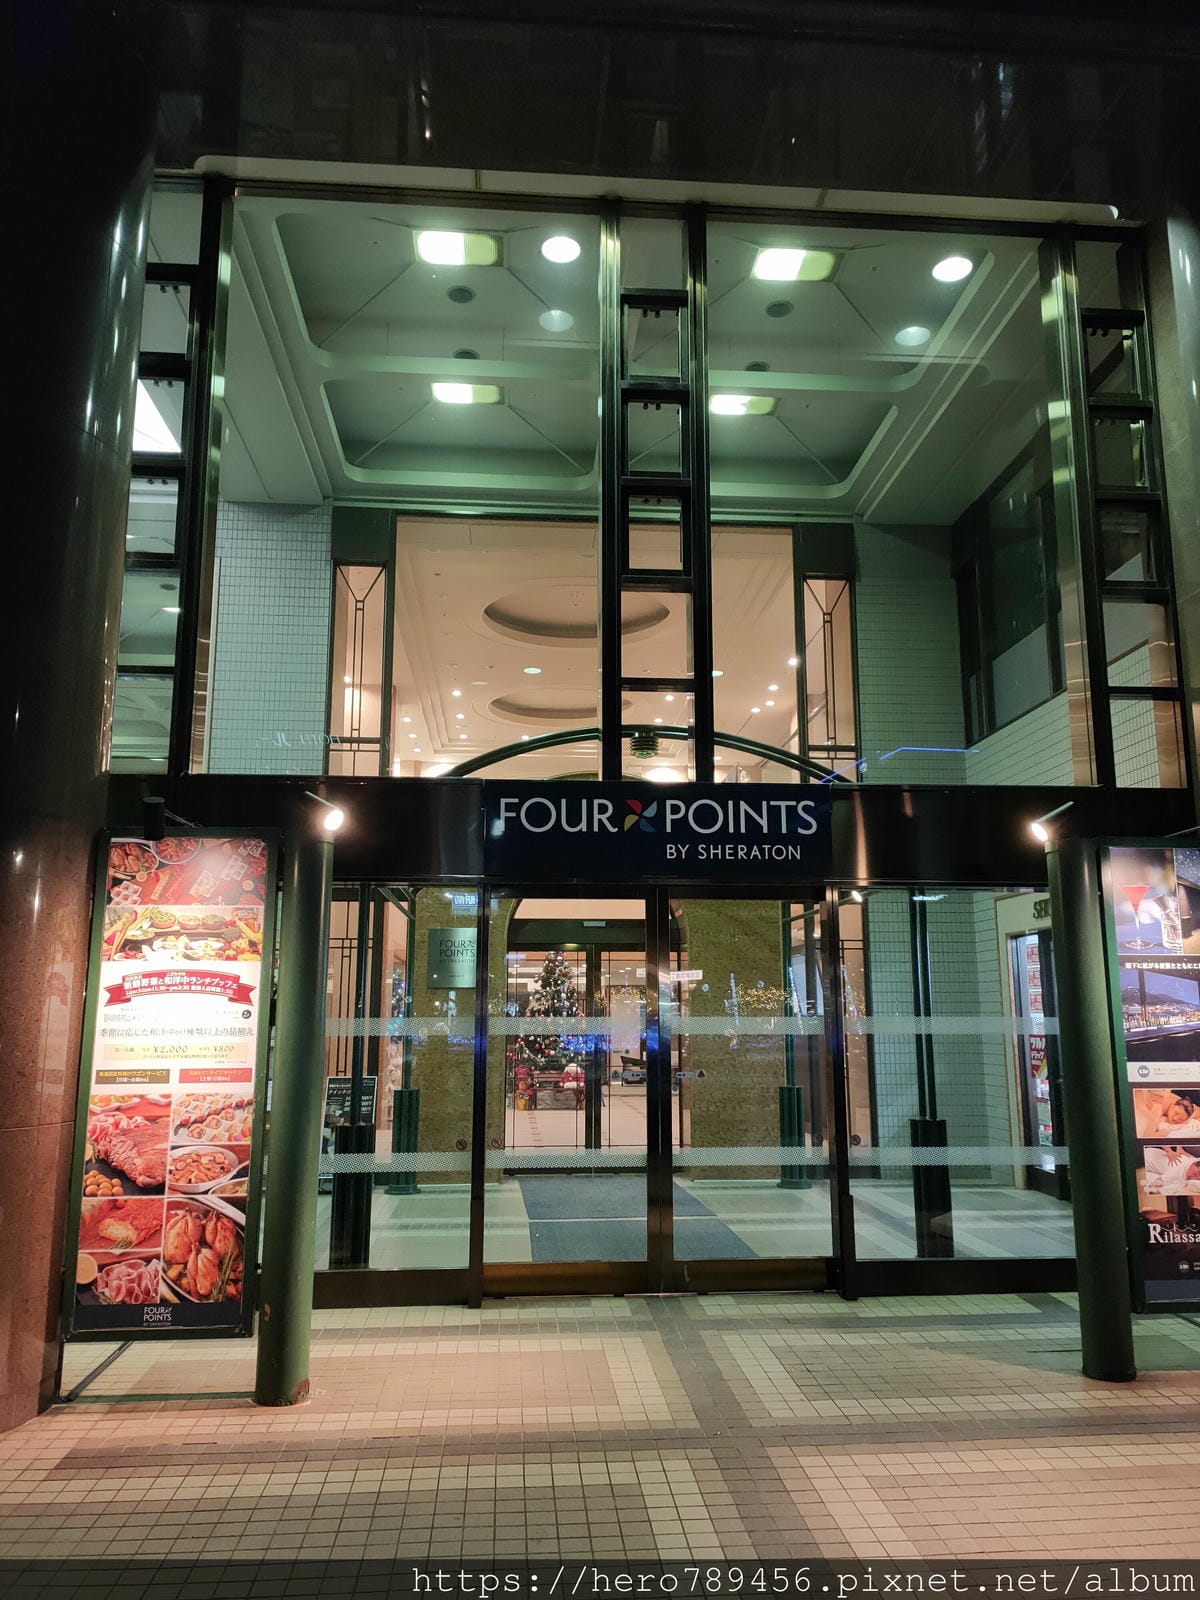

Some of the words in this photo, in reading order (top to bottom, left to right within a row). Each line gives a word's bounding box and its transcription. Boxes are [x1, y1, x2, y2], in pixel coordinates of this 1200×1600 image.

[499, 798, 617, 833] FOUR
[666, 799, 818, 835] POINTS
[667, 844, 690, 859] BY
[698, 844, 801, 860] SHERATON
[439, 939, 465, 948] FOUR
[439, 949, 475, 957] POINTS
[143, 1306, 165, 1314] FOUR
